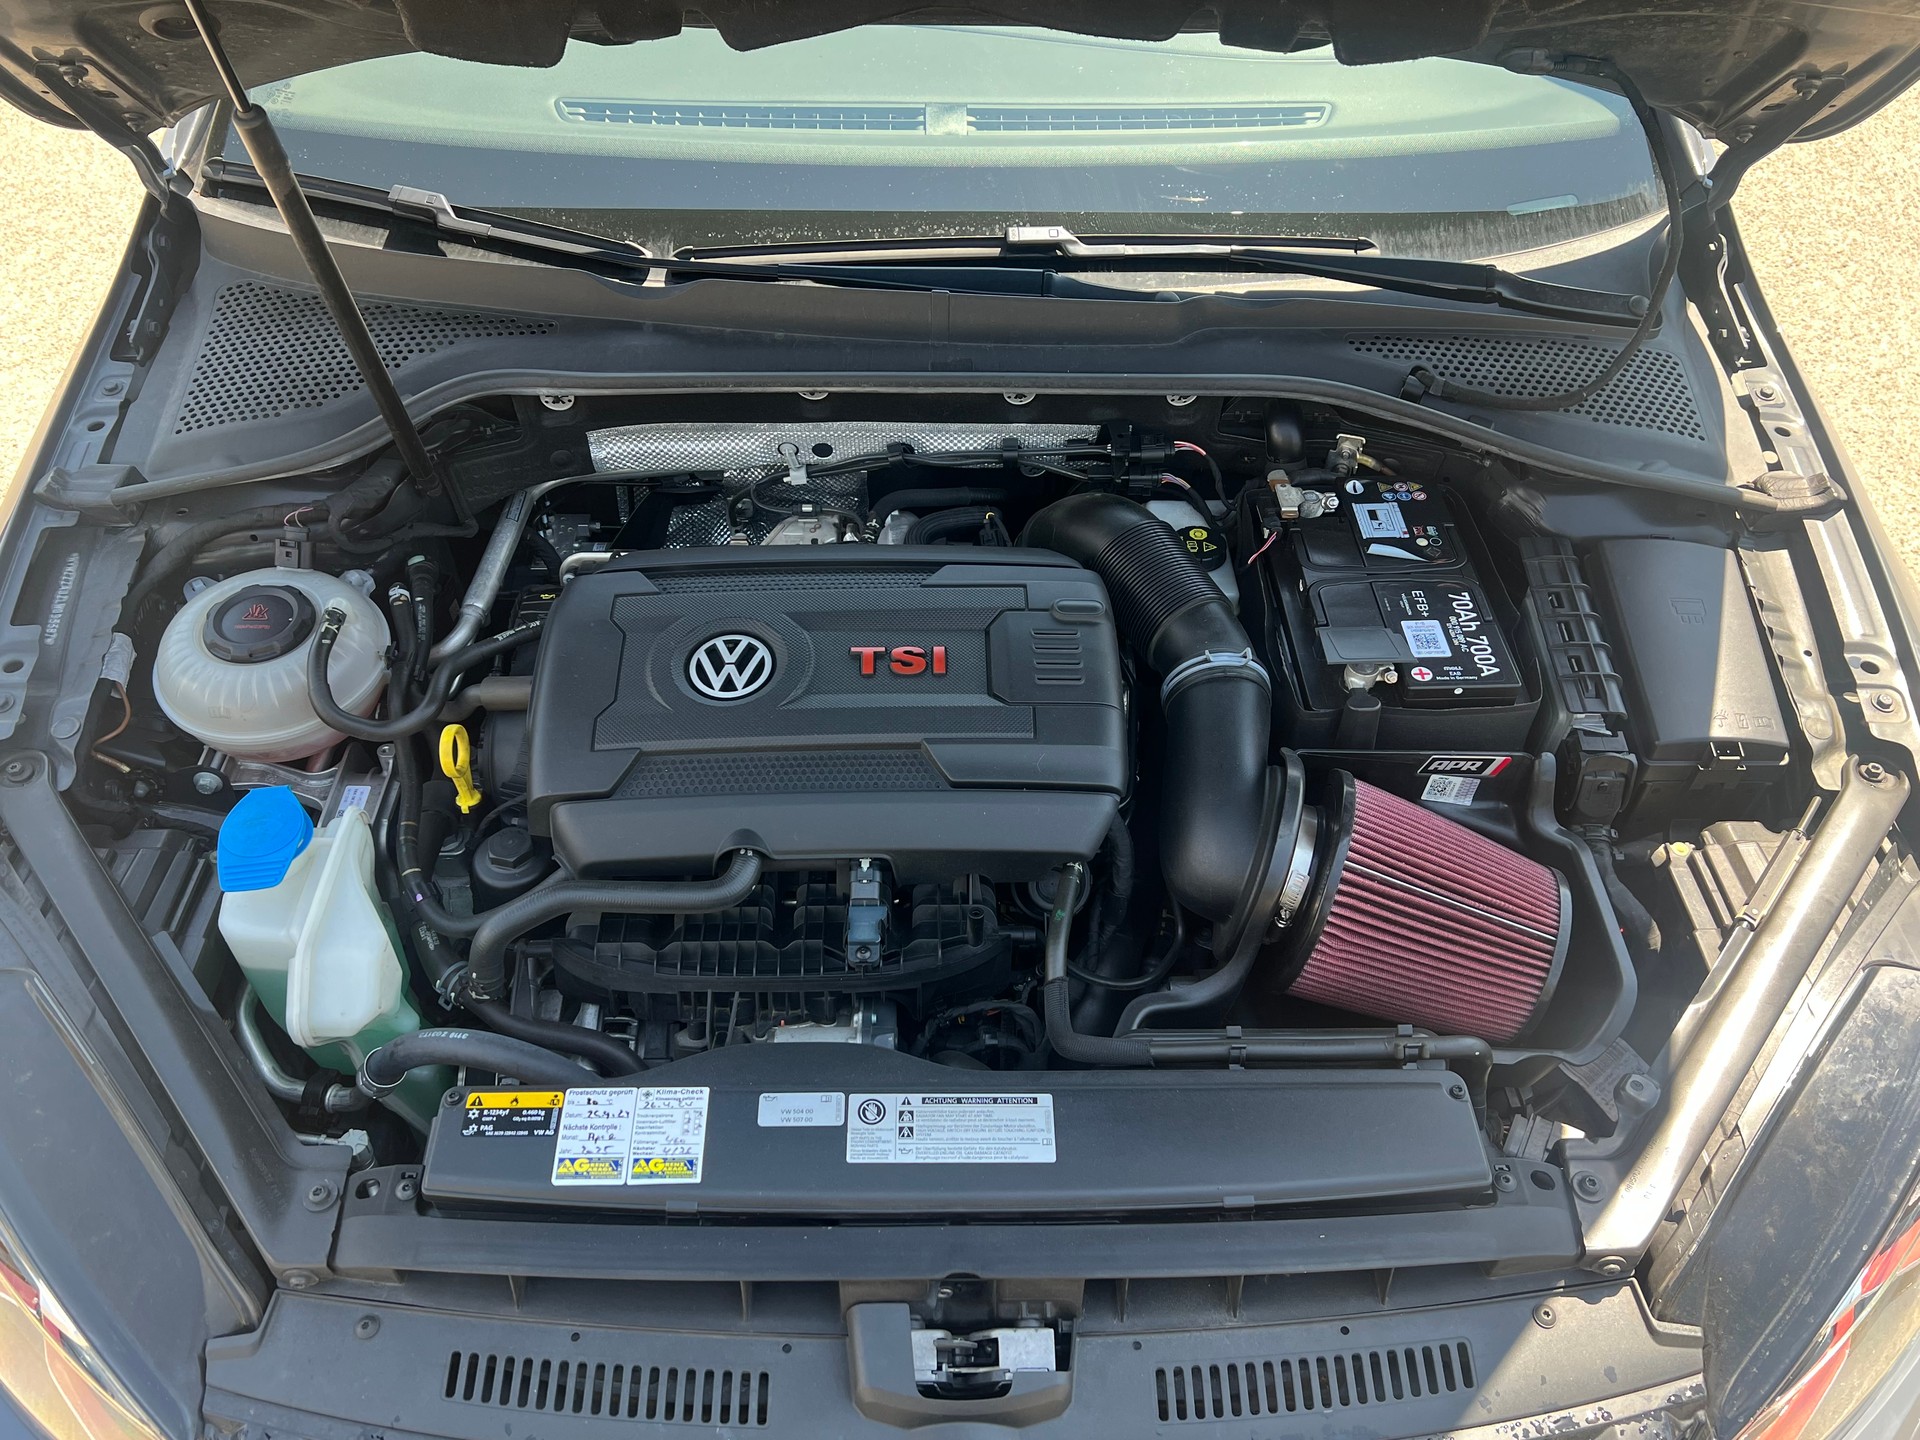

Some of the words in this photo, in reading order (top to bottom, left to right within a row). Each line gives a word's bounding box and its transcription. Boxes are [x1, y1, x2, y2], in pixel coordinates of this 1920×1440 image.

[1411, 590, 1429, 617] EFB+
[1448, 591, 1481, 632] 70Ah
[1466, 635, 1501, 677] 700A
[690, 634, 773, 699] VW
[850, 645, 947, 675] TSI
[1427, 760, 1484, 771] APR
